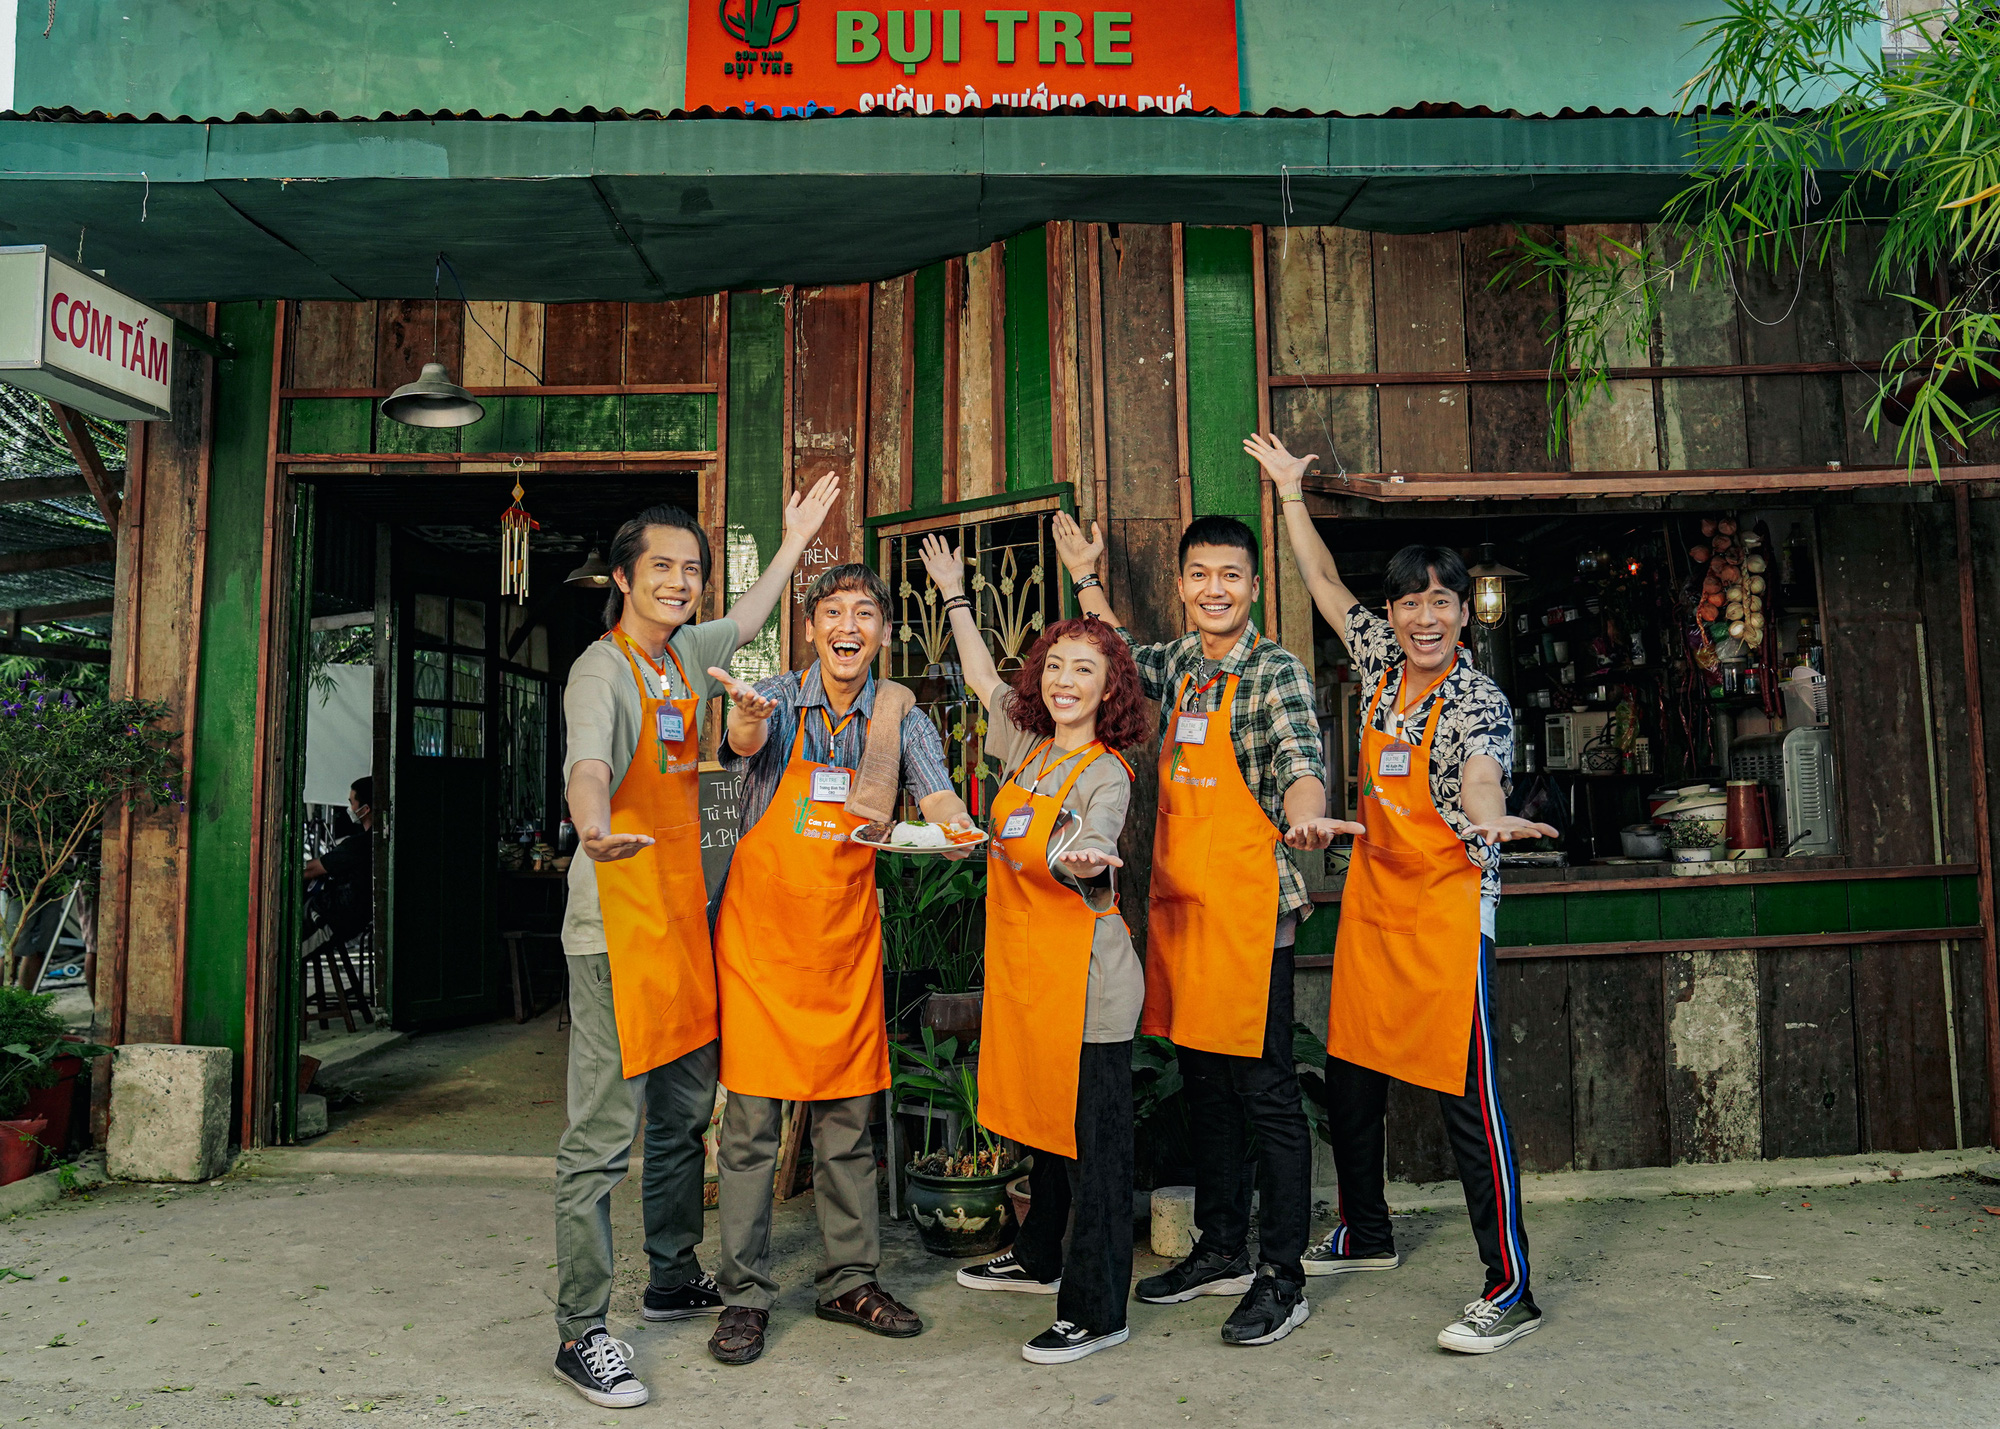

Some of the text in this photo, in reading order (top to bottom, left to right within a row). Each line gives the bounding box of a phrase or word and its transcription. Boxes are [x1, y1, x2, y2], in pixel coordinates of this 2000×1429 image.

[836, 9, 1133, 75] BỤI TRE
[724, 62, 792, 79] BỤI TRE
[51, 292, 168, 386] CƠM TẤM
[802, 537, 839, 566] TRÊN
